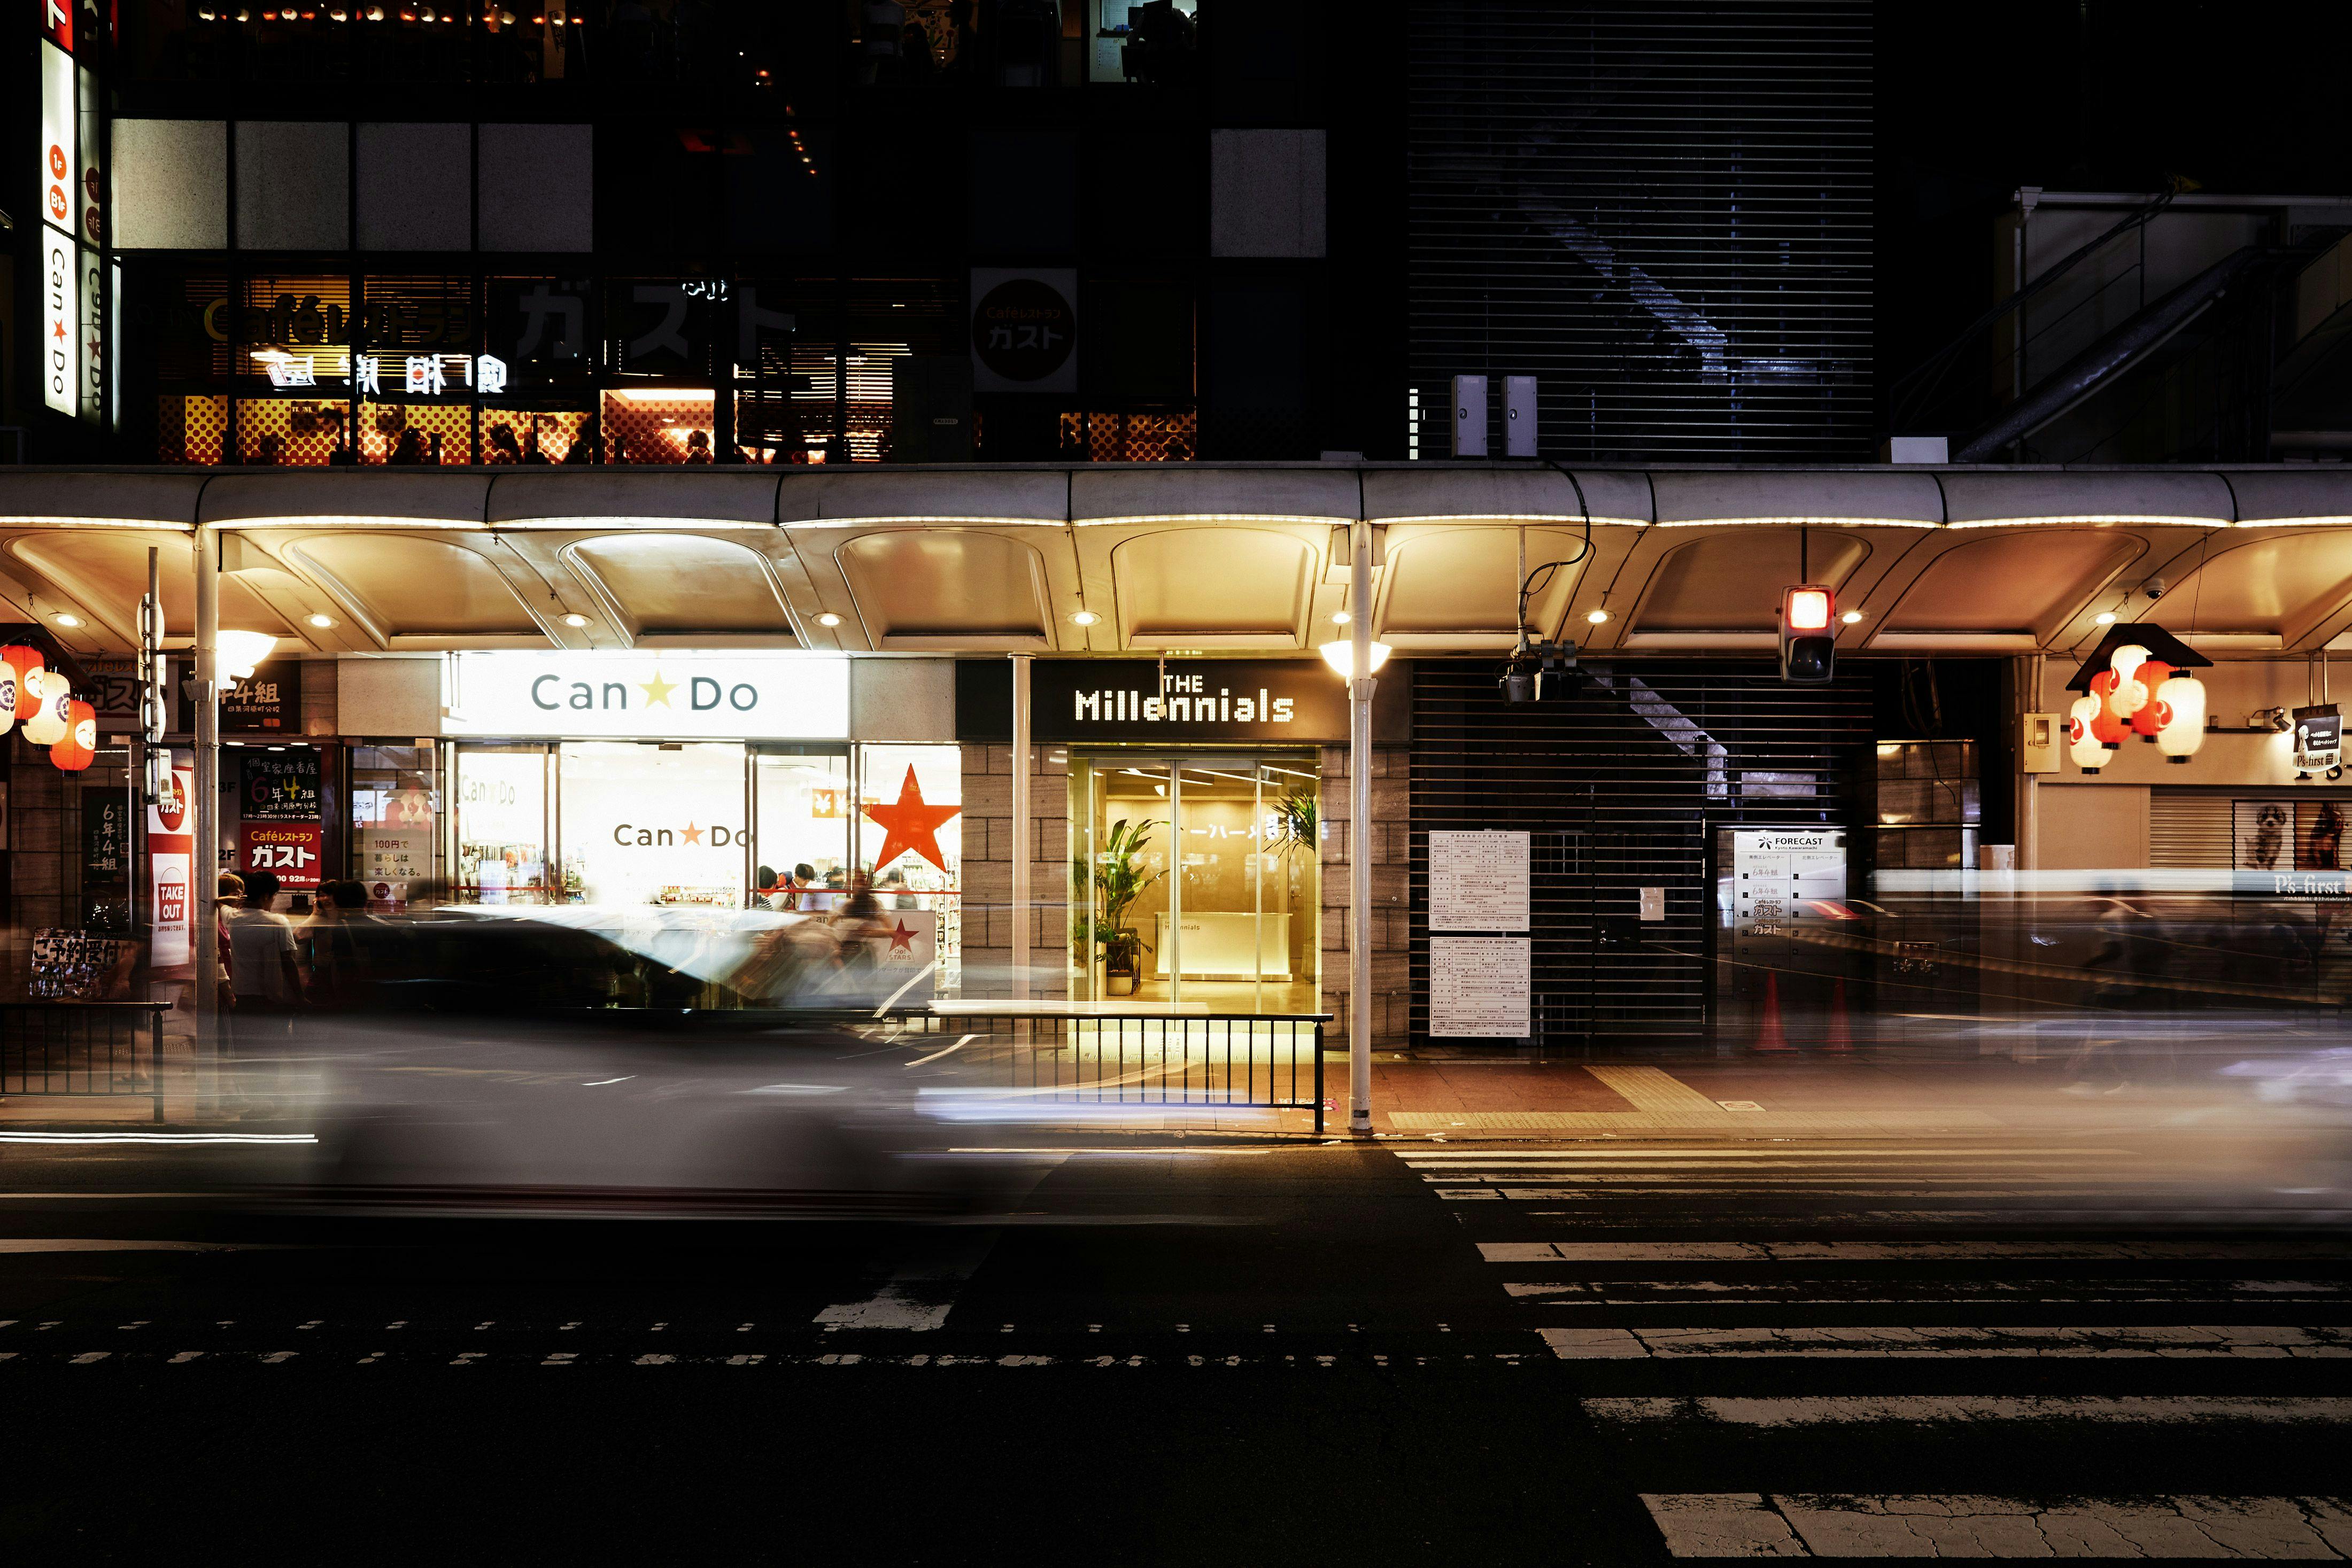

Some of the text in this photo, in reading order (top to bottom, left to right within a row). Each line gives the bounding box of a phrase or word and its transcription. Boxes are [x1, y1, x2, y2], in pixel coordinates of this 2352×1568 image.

[53, 154, 62, 170] 1F
[51, 191, 65, 212] B1F
[52, 247, 65, 394] Can Do
[516, 280, 796, 360] ガスト
[987, 323, 1064, 351] ガスト
[531, 674, 759, 711] Can Do
[1164, 675, 1203, 693] THE
[1075, 688, 1294, 722] Millennials
[219, 781, 236, 793] 3F
[461, 774, 515, 805] Can Do
[102, 804, 118, 871] 6年4組
[251, 830, 313, 842] Caféレストラン
[374, 840, 409, 849] 100円で
[614, 824, 754, 848] Can Do
[218, 849, 236, 860] 2F
[252, 844, 315, 868] ガスト
[374, 854, 409, 862] 暮らしは
[374, 867, 421, 876] 楽しくなる。
[2274, 874, 2341, 894] P's-first
[160, 886, 184, 901] TAKE
[163, 904, 181, 919] OUT
[1753, 905, 1782, 917] ガスト
[1753, 923, 1782, 935] ガスト
